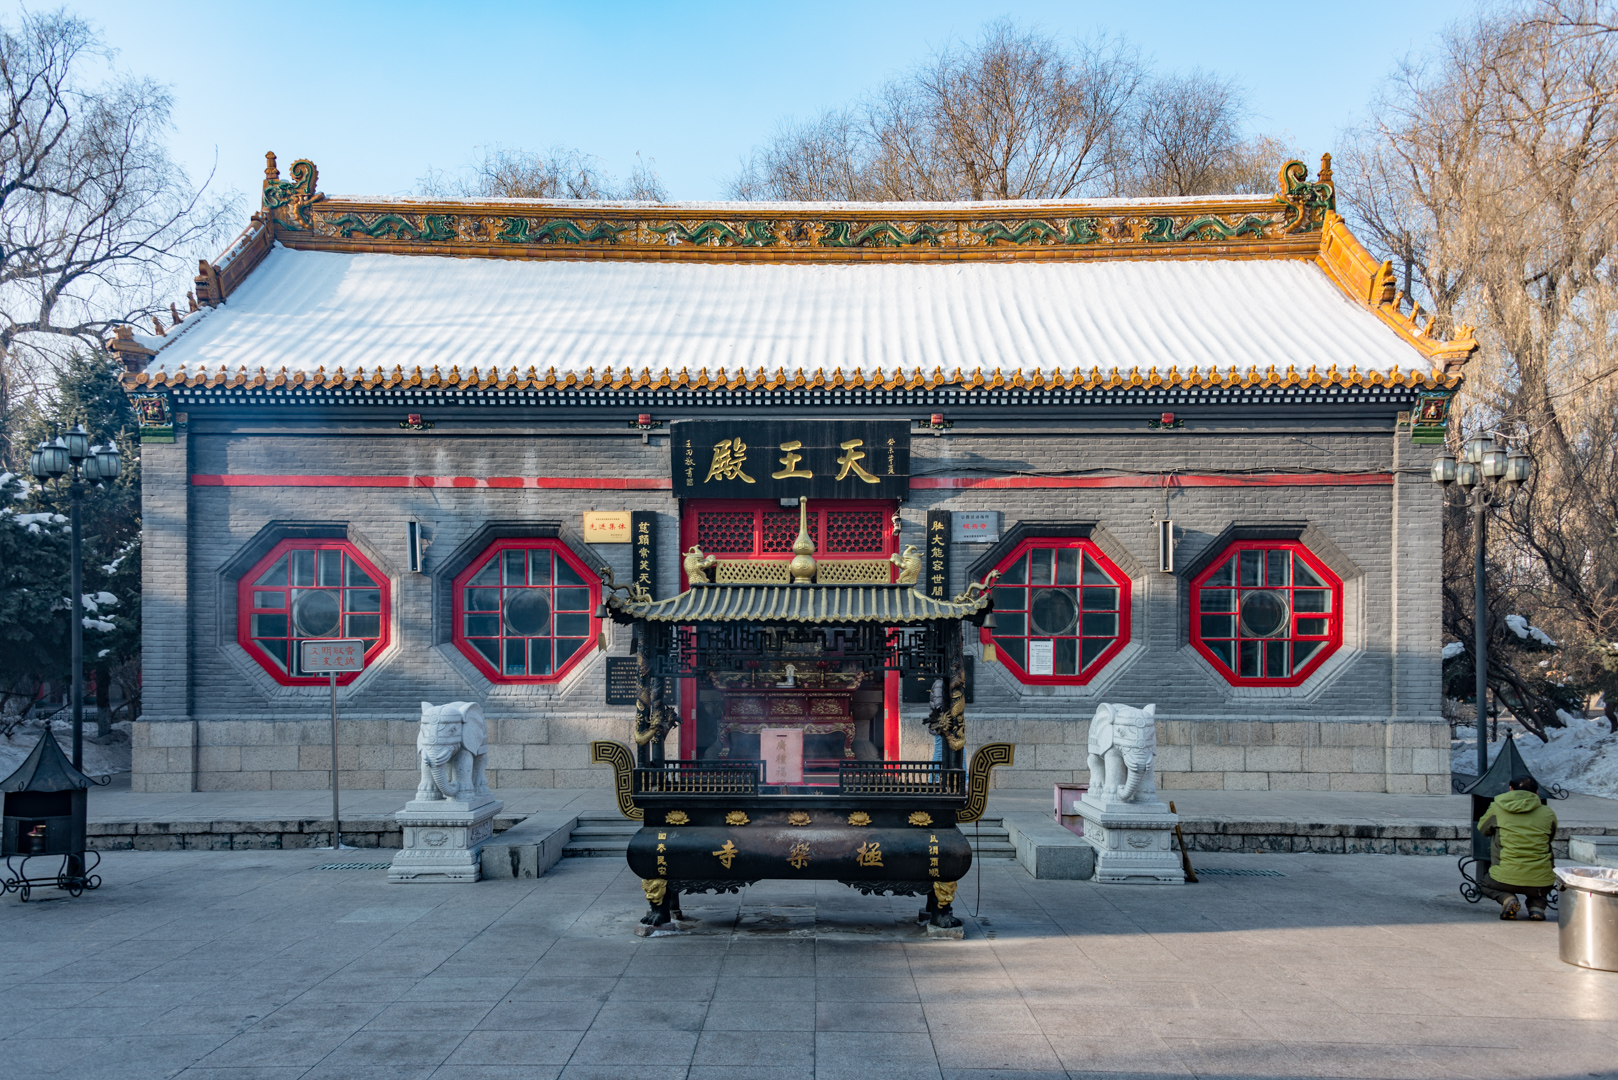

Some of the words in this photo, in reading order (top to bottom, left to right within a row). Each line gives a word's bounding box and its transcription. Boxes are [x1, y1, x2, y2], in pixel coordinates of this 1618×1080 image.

[704, 436, 881, 484] 天王殿
[712, 839, 885, 870] 極樂寺
